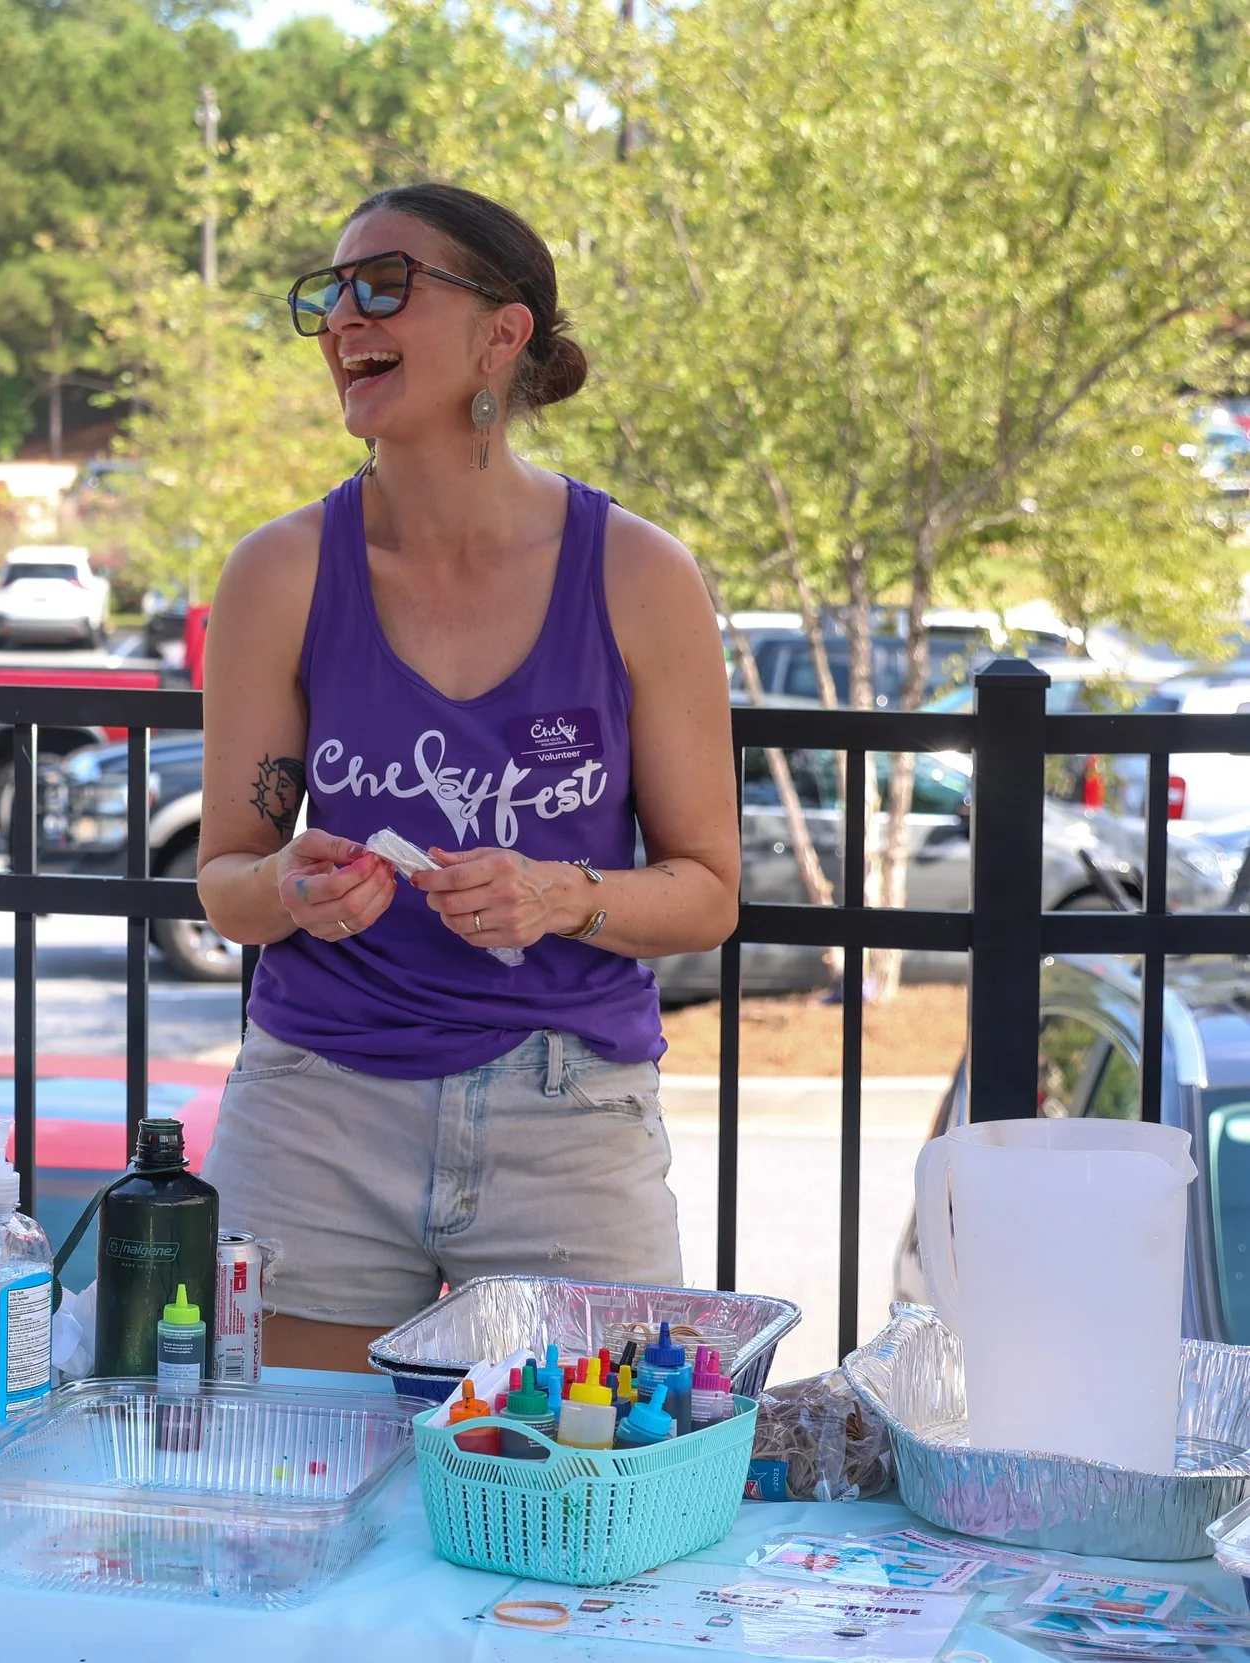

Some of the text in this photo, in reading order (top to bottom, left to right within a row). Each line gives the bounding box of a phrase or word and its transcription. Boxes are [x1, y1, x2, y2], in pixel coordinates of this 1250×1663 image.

[538, 750, 581, 762] Volunteer
[123, 1244, 173, 1258] nalgene
[864, 1605, 922, 1616] THREE
